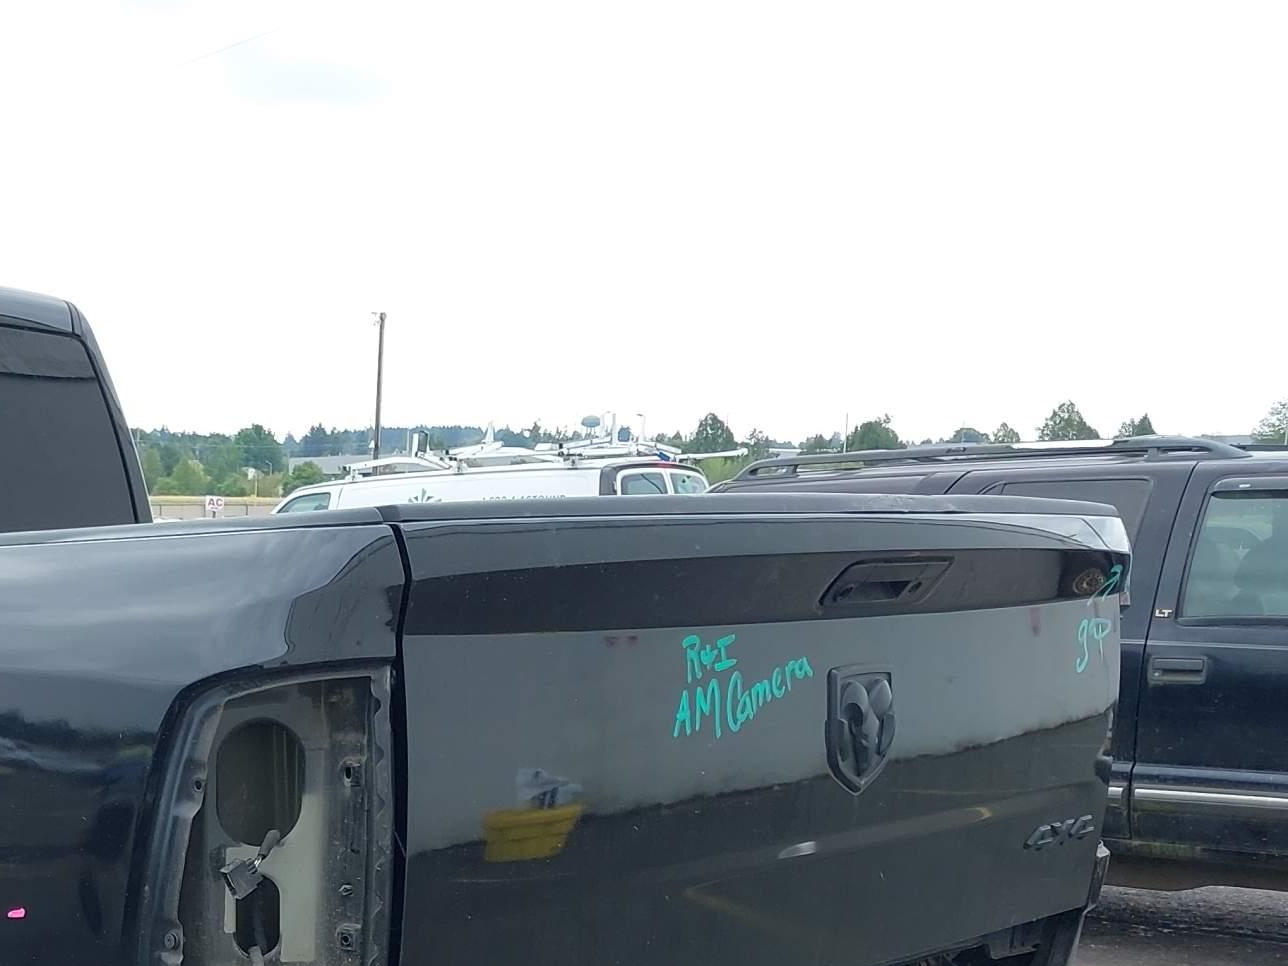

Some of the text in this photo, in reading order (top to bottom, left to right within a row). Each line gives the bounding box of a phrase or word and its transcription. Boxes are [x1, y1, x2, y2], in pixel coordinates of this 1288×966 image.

[1154, 608, 1173, 618] LT
[673, 656, 814, 739] AM Camera
